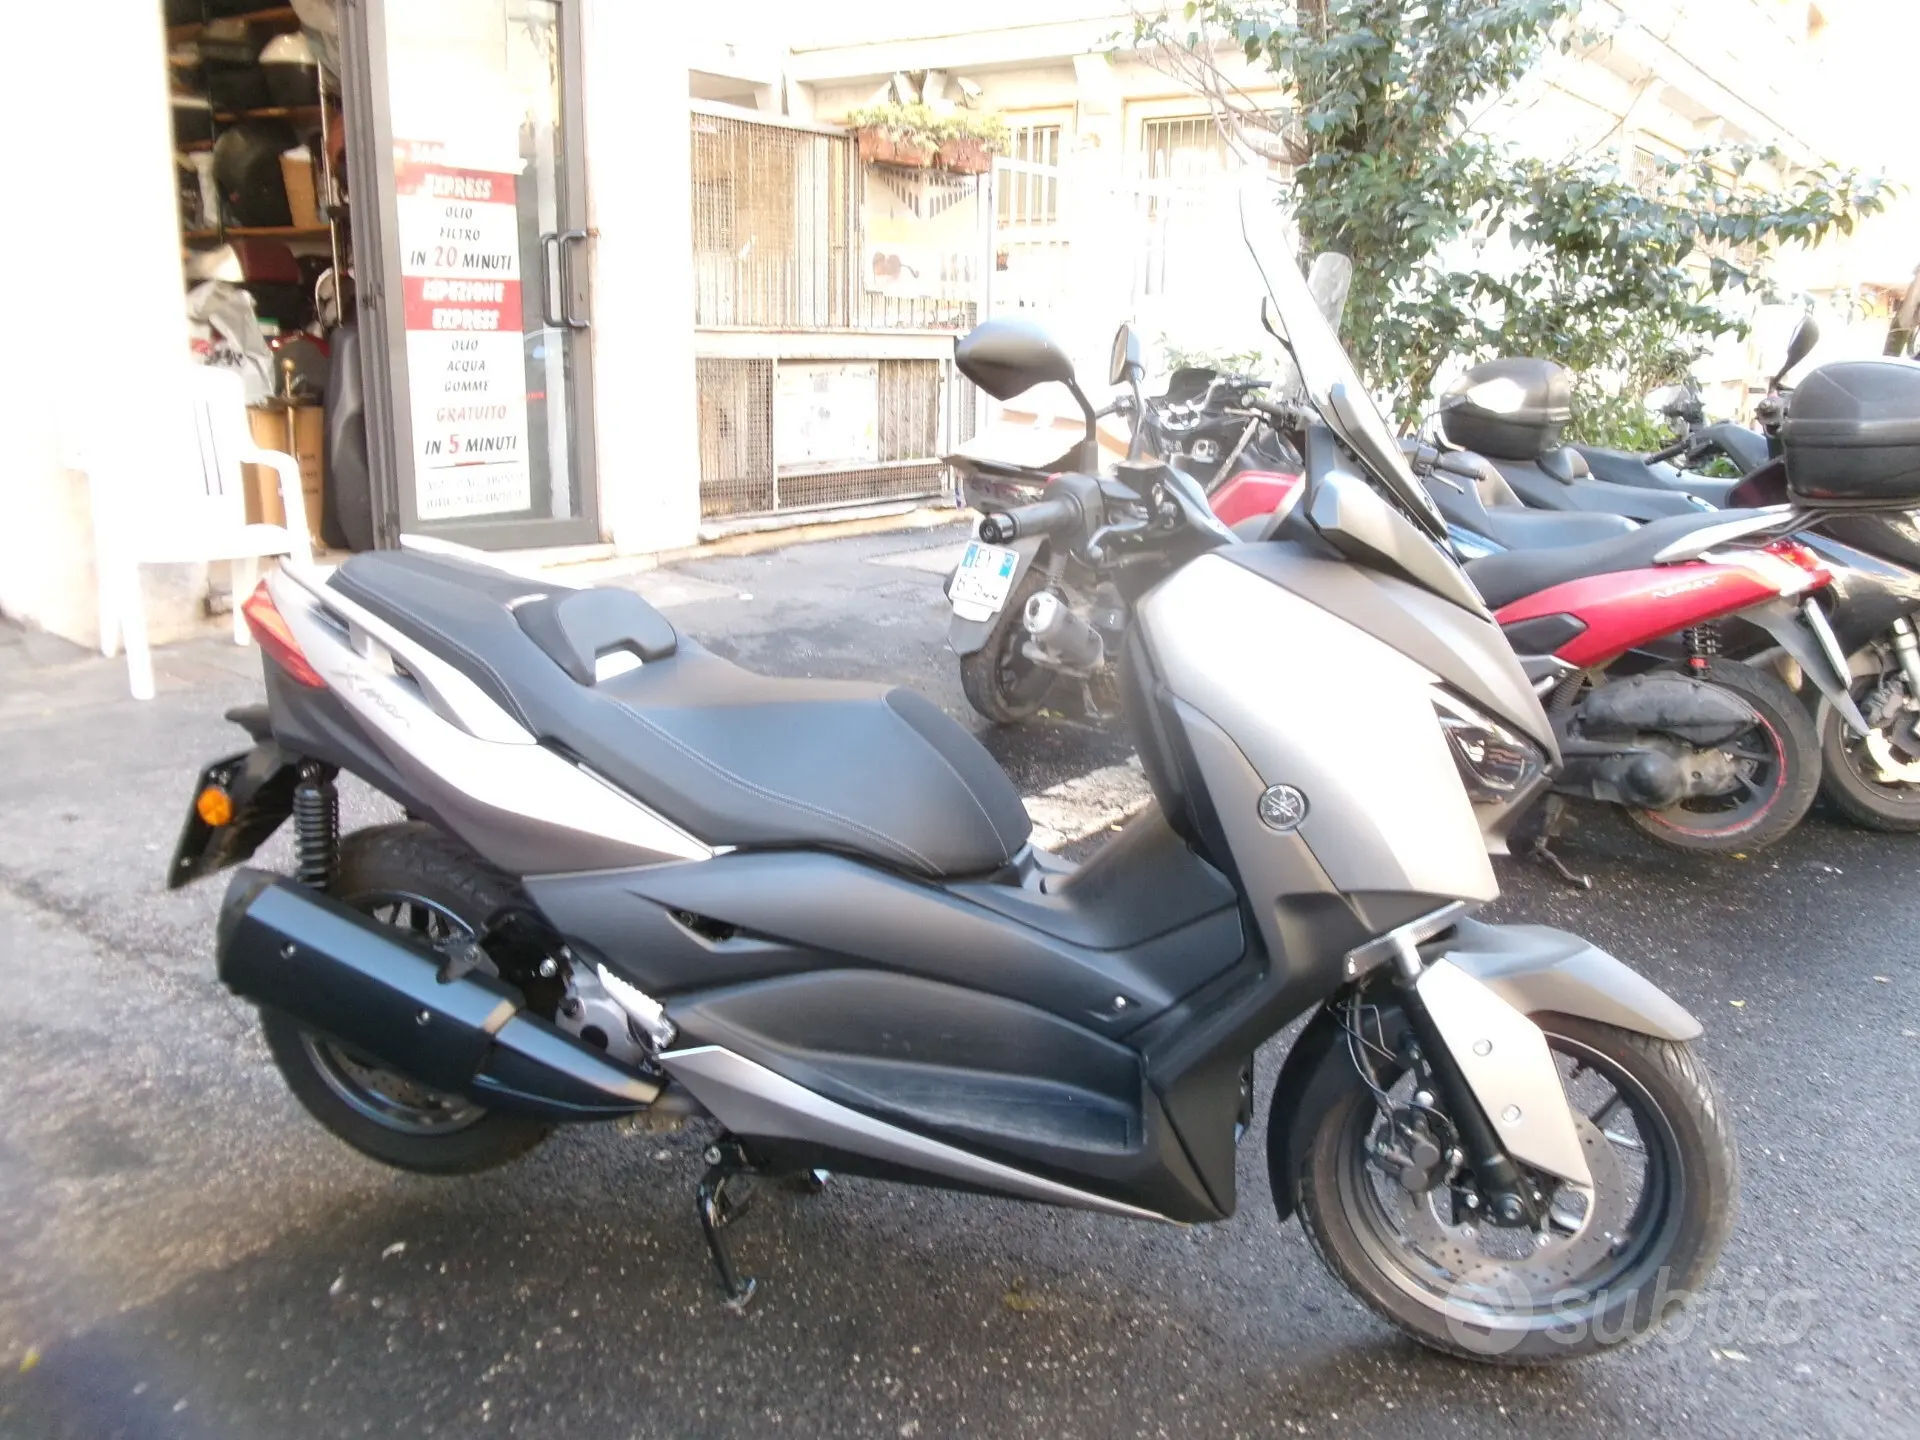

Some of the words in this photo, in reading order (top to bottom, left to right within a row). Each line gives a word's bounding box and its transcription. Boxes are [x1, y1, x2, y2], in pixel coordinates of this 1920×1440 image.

[445, 206, 473, 220] OLIO
[439, 226, 481, 242] FILTRO
[410, 250, 427, 266] IN
[434, 246, 458, 267] 20
[462, 252, 512, 271] MINUTI
[451, 339, 479, 352] OLIO
[447, 360, 486, 374] ACQUA
[444, 380, 490, 393] GOMME
[436, 405, 507, 423] GRATUITO
[425, 440, 442, 455] IN
[448, 434, 460, 455] 5
[465, 435, 517, 453] MINUTI
